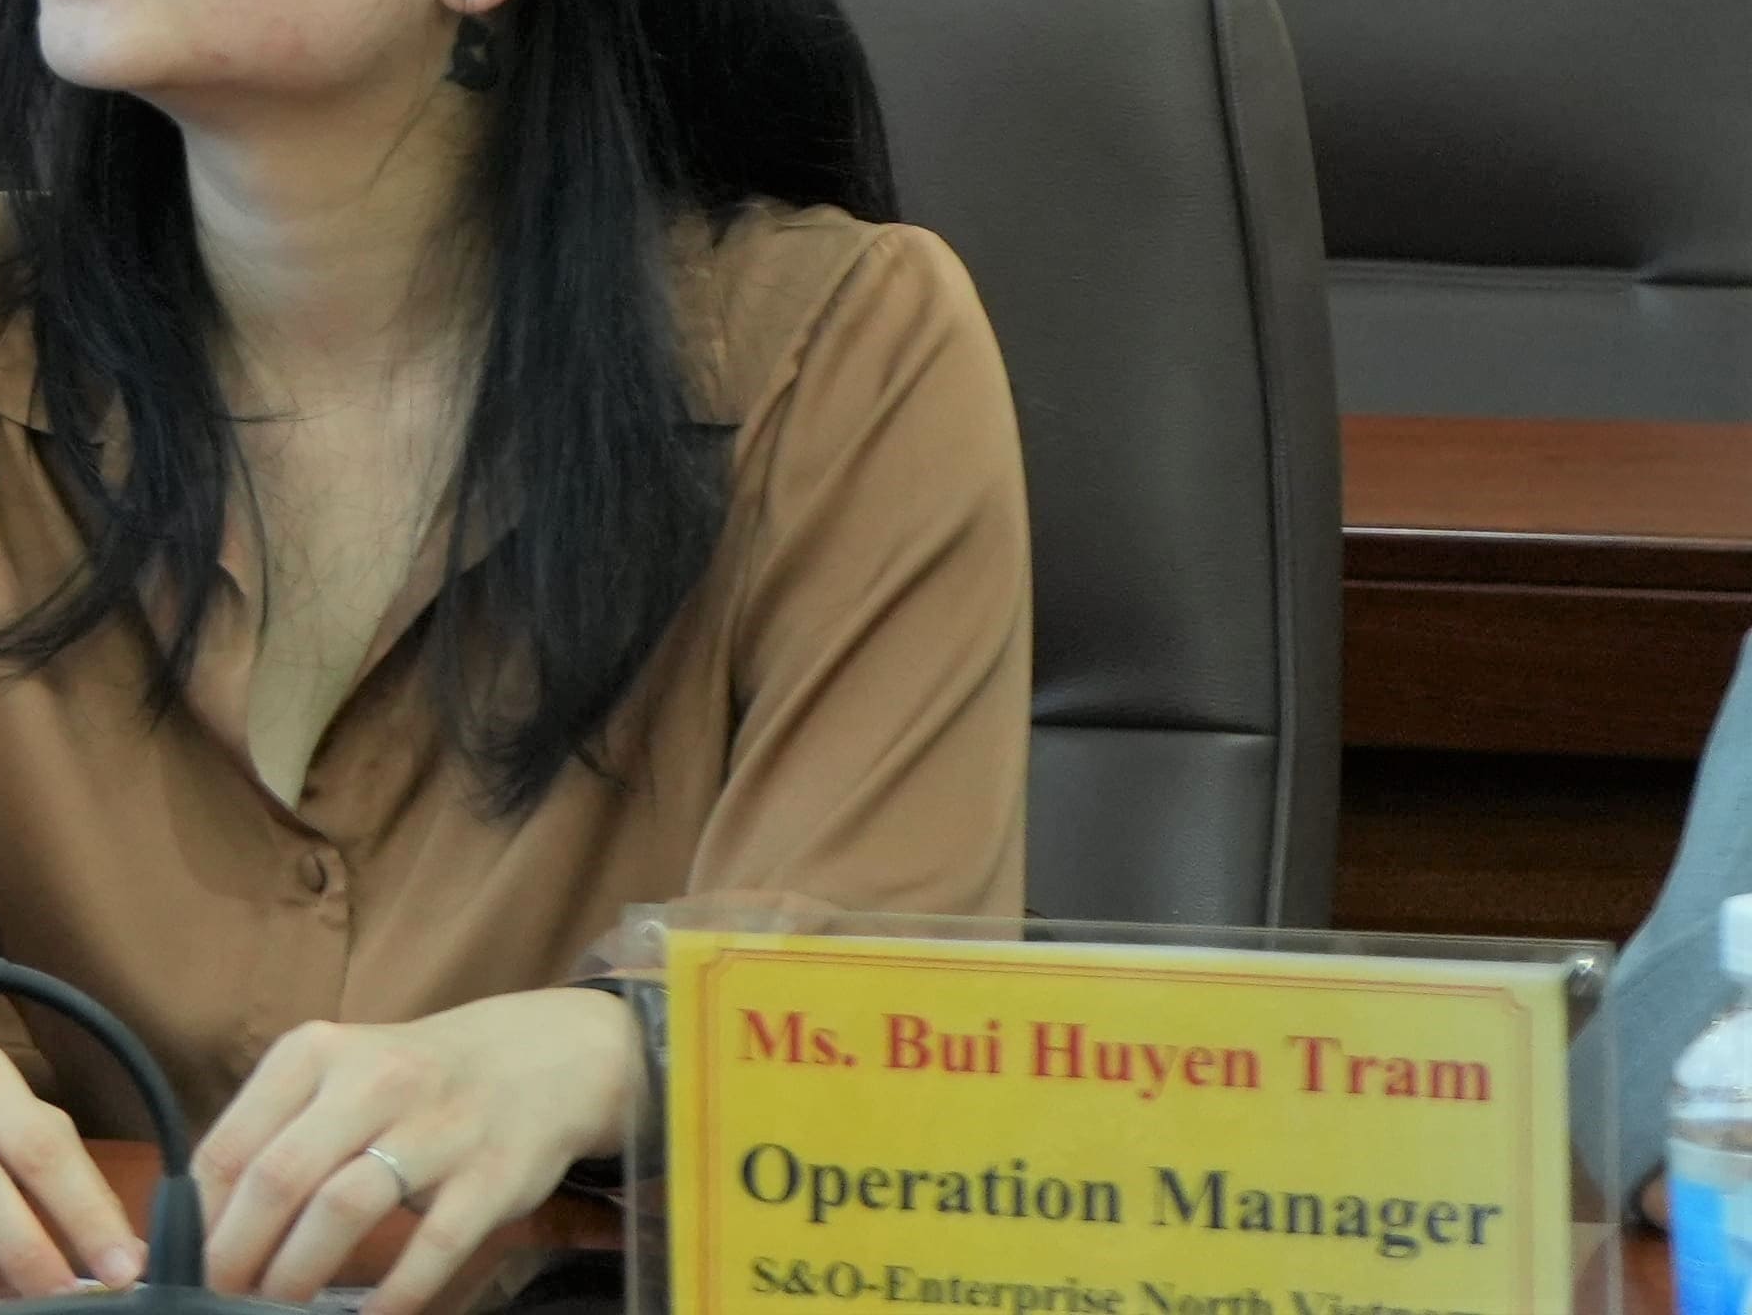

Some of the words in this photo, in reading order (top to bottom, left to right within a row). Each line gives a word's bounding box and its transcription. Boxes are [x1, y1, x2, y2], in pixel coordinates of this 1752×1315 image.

[735, 1006, 858, 1070] Ms.
[881, 1010, 1003, 1077] Bui
[1028, 1020, 1262, 1102] Huyen
[1285, 1034, 1493, 1104] Tram
[737, 1140, 1123, 1228] Operation
[1150, 1164, 1504, 1260] Manager
[750, 1255, 1124, 1315] S&O-Enterprise
